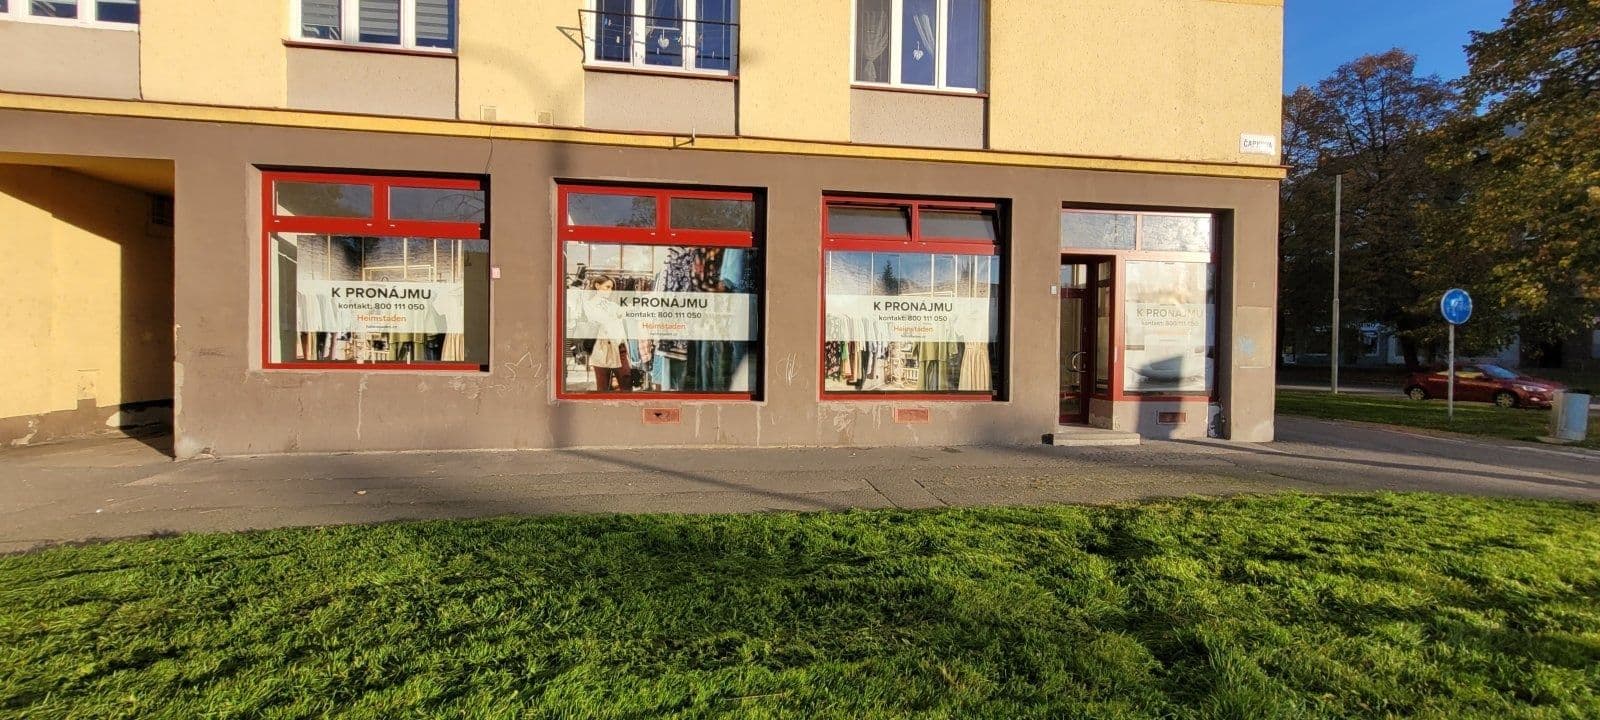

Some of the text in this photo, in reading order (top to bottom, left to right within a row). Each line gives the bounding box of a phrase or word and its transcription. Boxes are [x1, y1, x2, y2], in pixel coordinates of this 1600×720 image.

[331, 286, 432, 300] K PRONÁJMU
[338, 302, 373, 310] kontakt:
[407, 303, 425, 311] 050
[619, 295, 708, 309] K PRONÁJMU
[873, 300, 953, 312] K PRONÁJMU
[625, 311, 656, 319] kontakt:
[657, 311, 673, 319] 800
[1136, 308, 1144, 317] K
[357, 314, 407, 323] Heimstaden
[642, 322, 686, 330] Heimstaden
